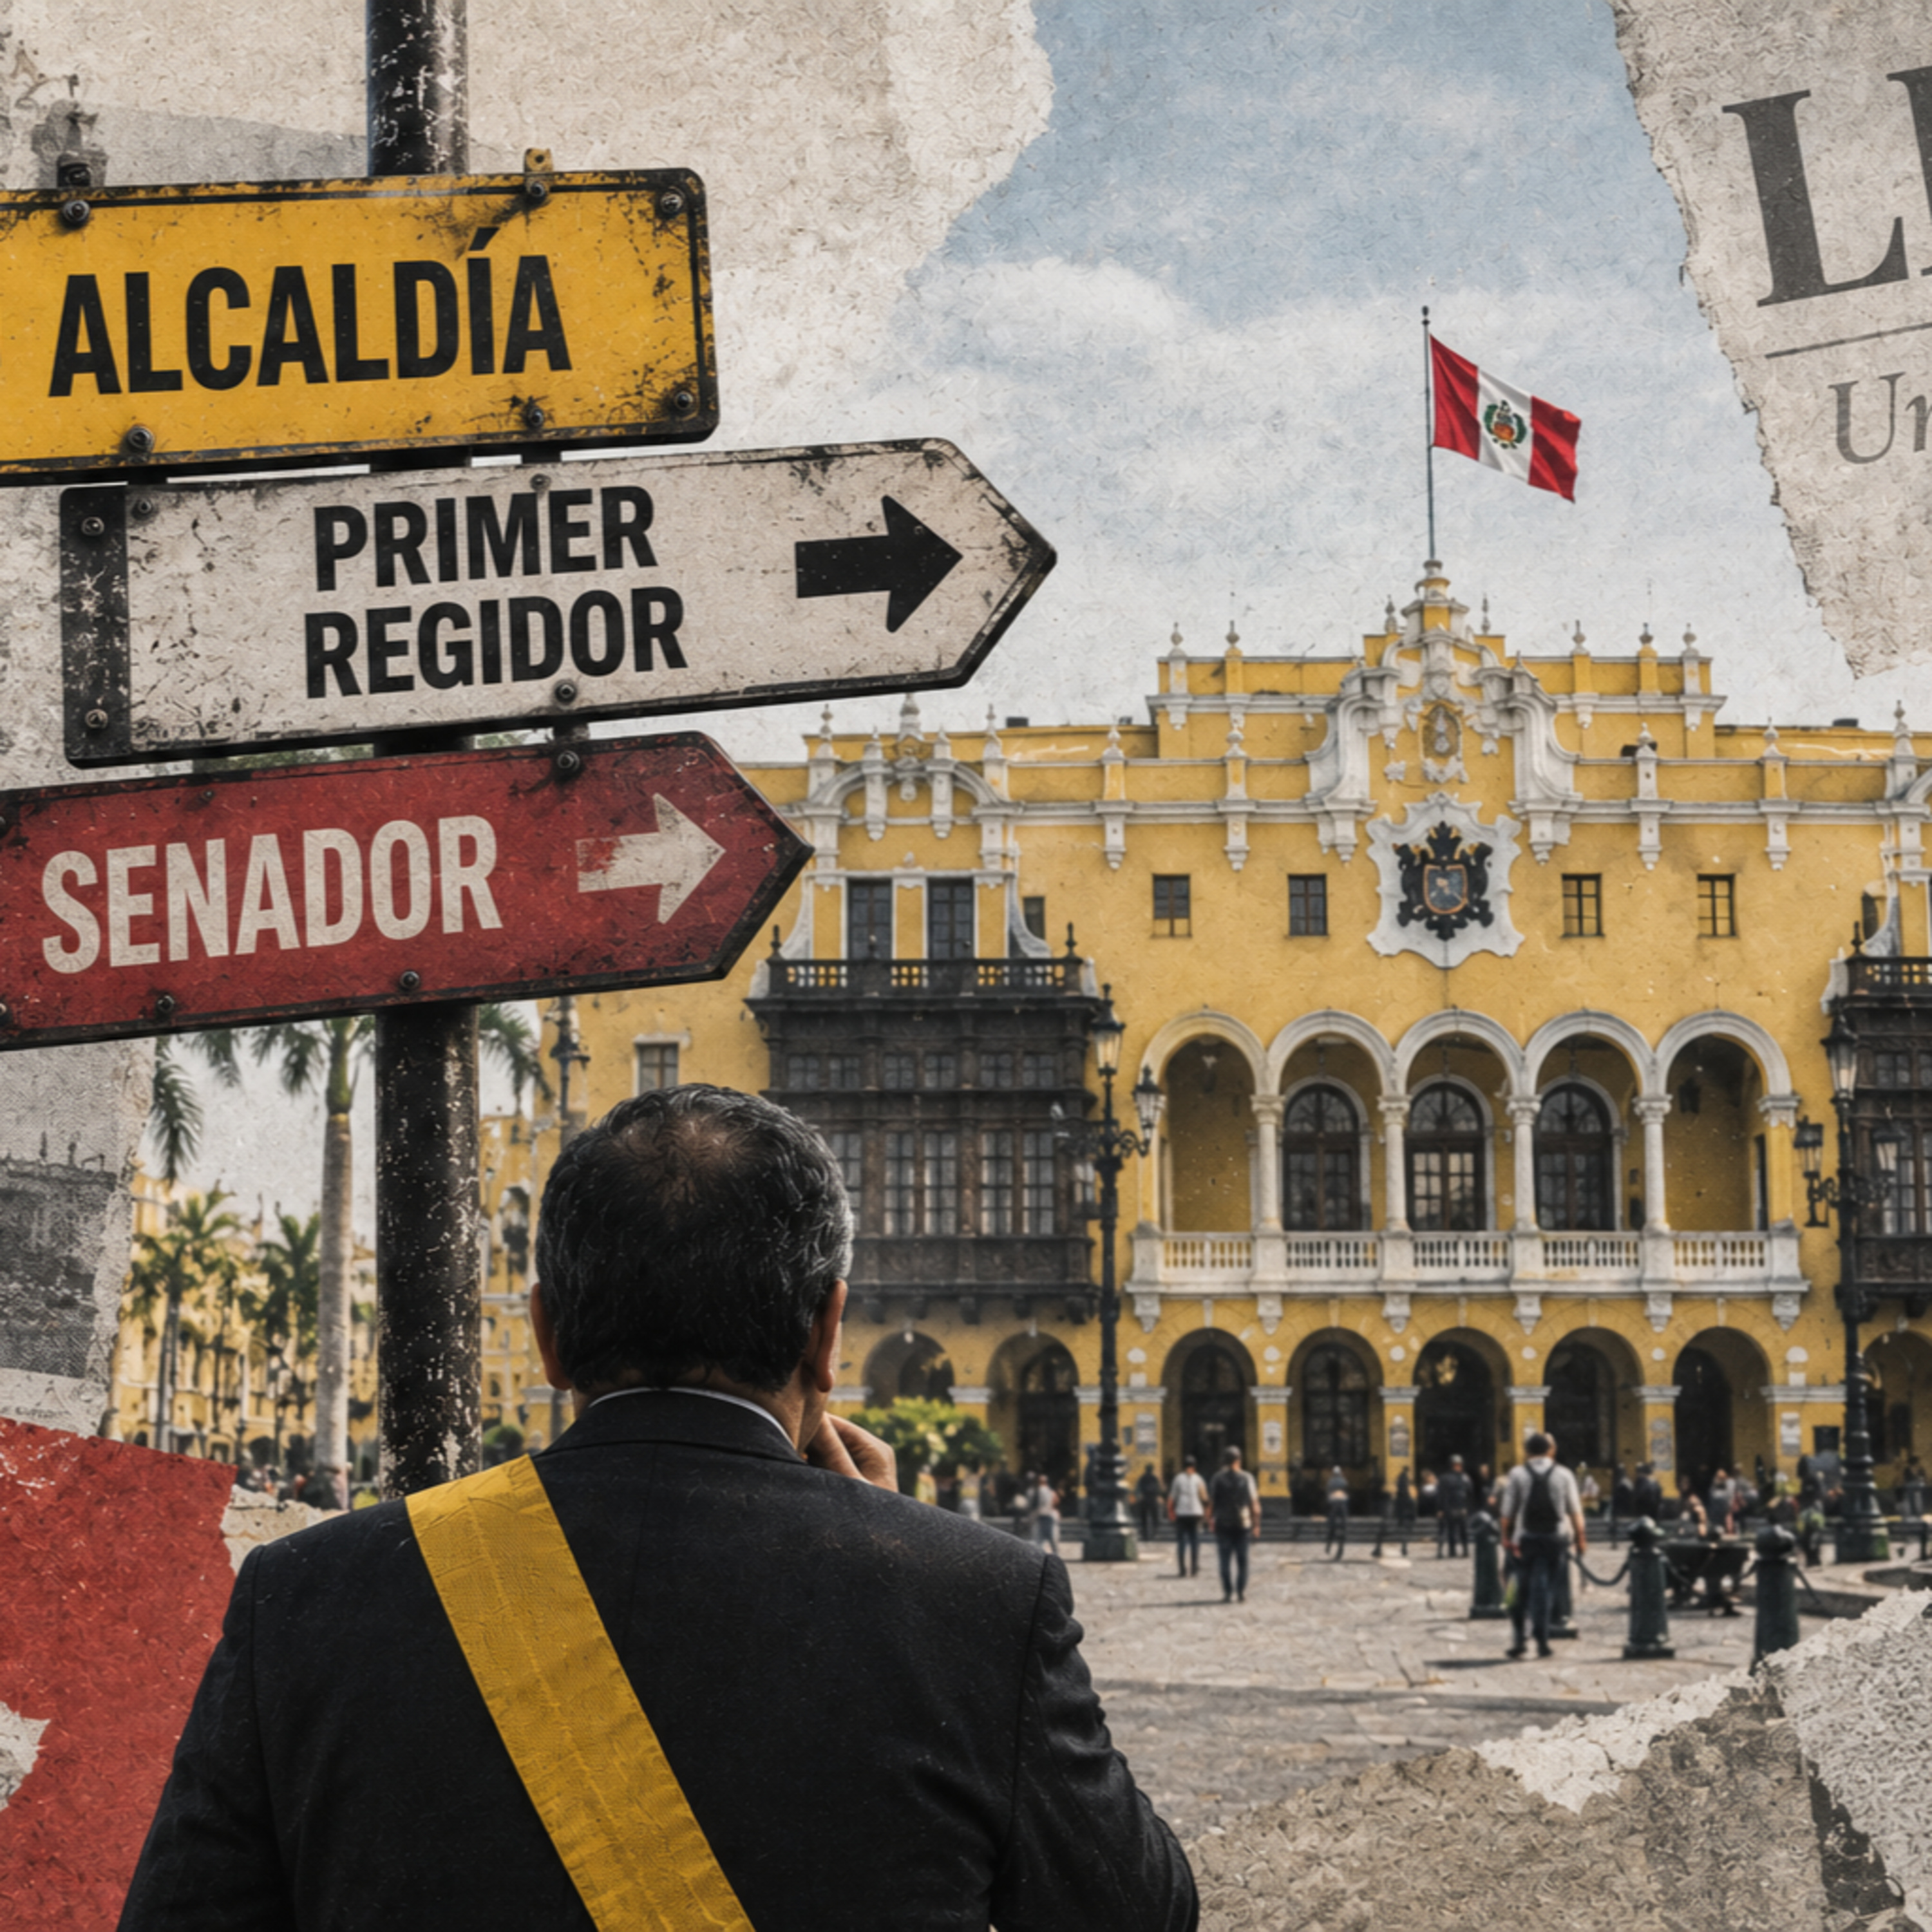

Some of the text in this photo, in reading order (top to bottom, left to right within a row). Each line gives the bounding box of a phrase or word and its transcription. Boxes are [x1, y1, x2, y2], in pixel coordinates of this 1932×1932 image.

[48, 227, 573, 398] ALCALDÍA
[314, 486, 658, 592] PRIMER
[305, 586, 688, 699] REGIDOR
[42, 815, 503, 974] SENADOR
